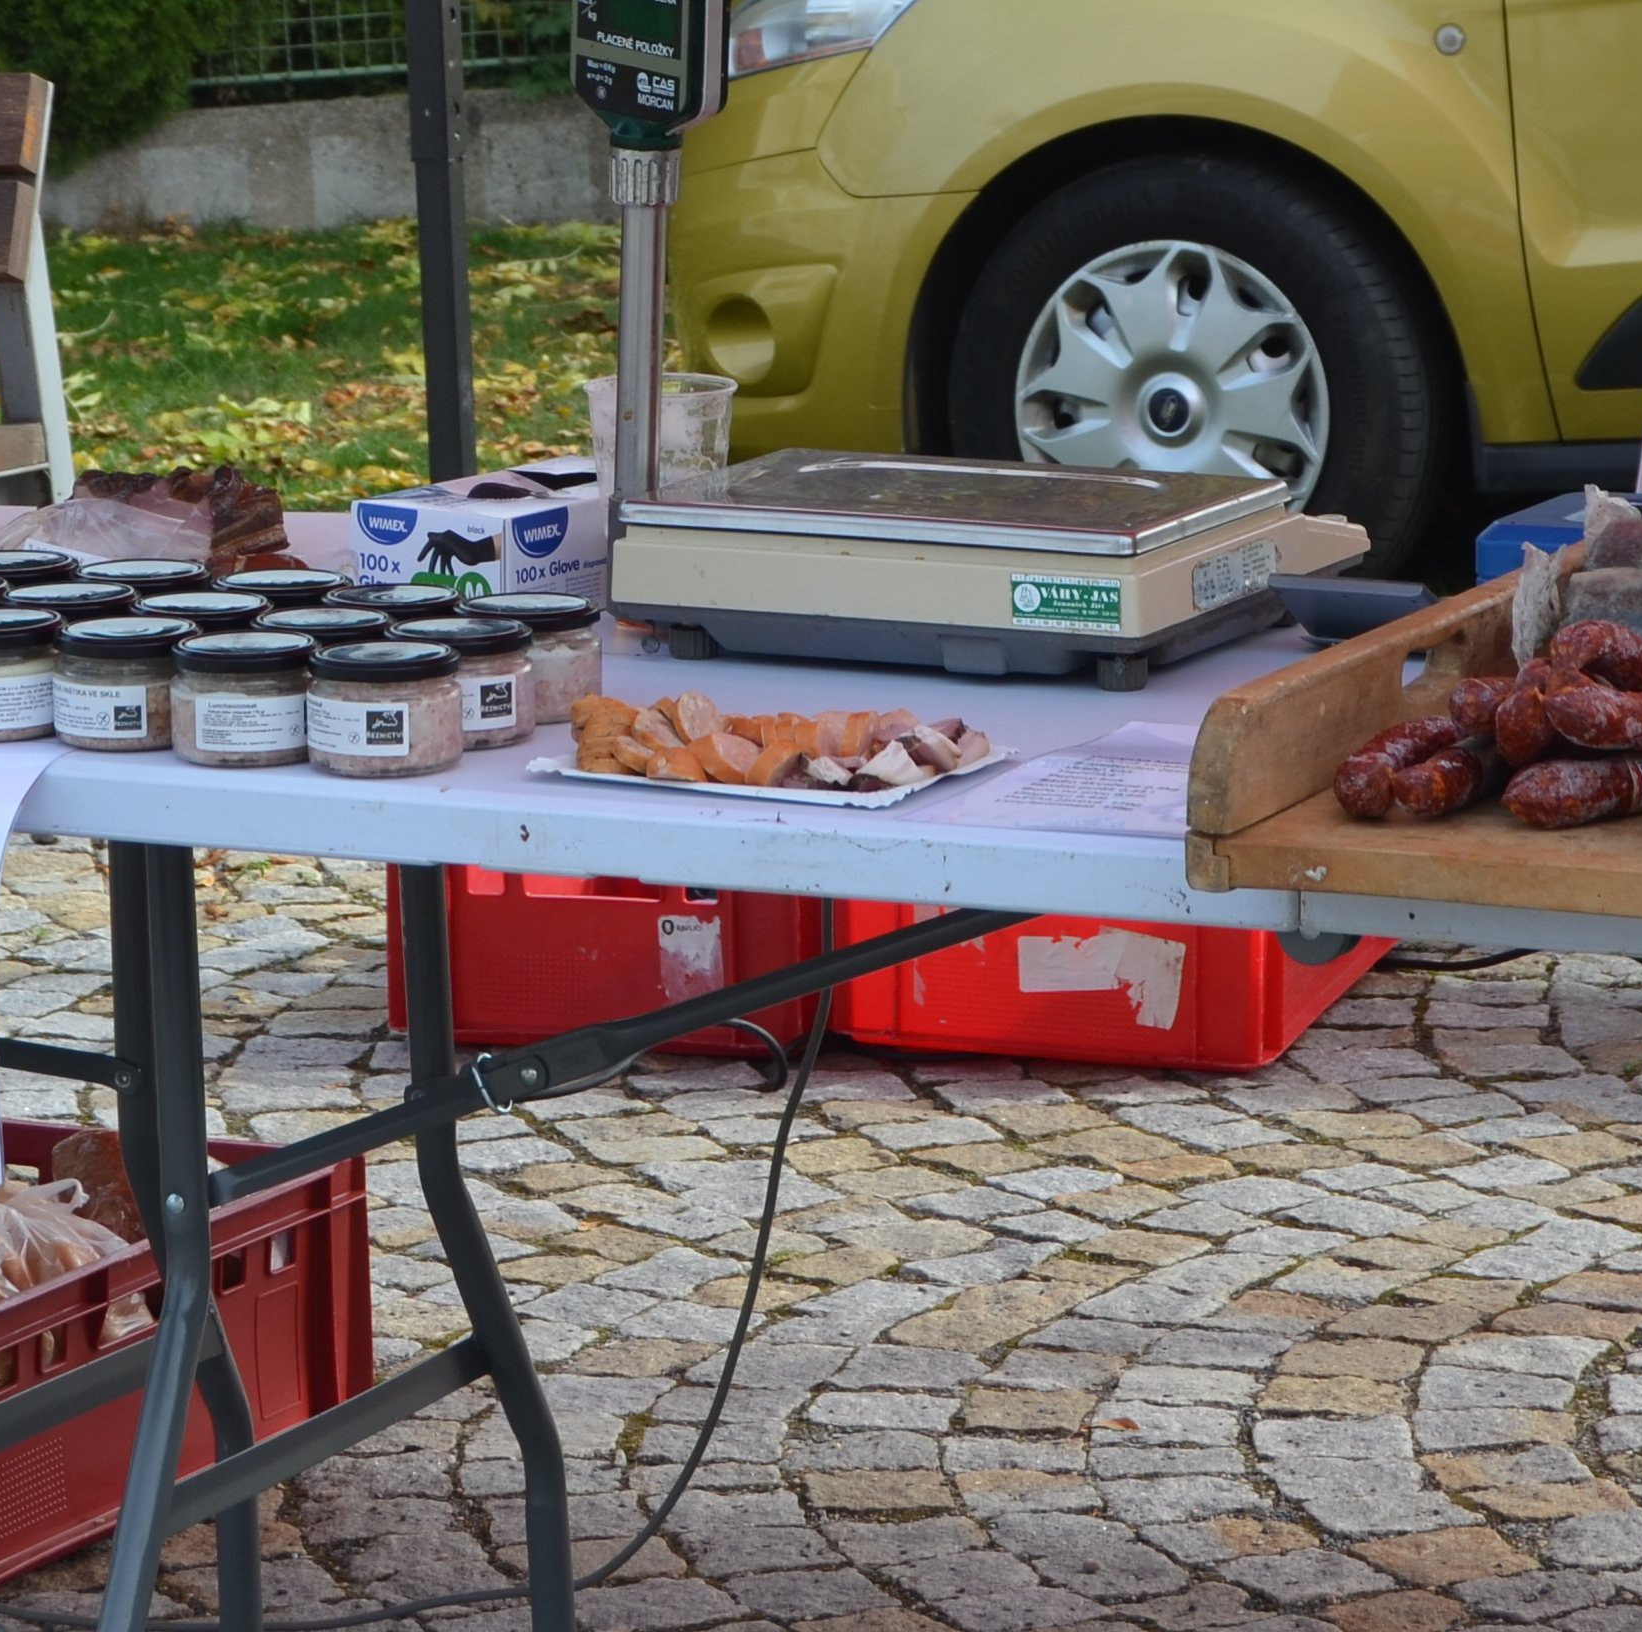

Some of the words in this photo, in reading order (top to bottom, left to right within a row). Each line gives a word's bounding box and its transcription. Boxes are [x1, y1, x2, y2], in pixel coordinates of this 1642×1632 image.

[597, 31, 634, 50] PLACENÉ
[635, 39, 675, 58] POLOŽKY
[652, 76, 675, 91] CAS
[637, 93, 674, 111] MORCAN
[360, 553, 388, 573] 100
[391, 560, 401, 573] x
[516, 567, 536, 585] 100
[538, 568, 546, 579] x
[549, 557, 579, 577] Glove
[1091, 590, 1118, 603] JAS
